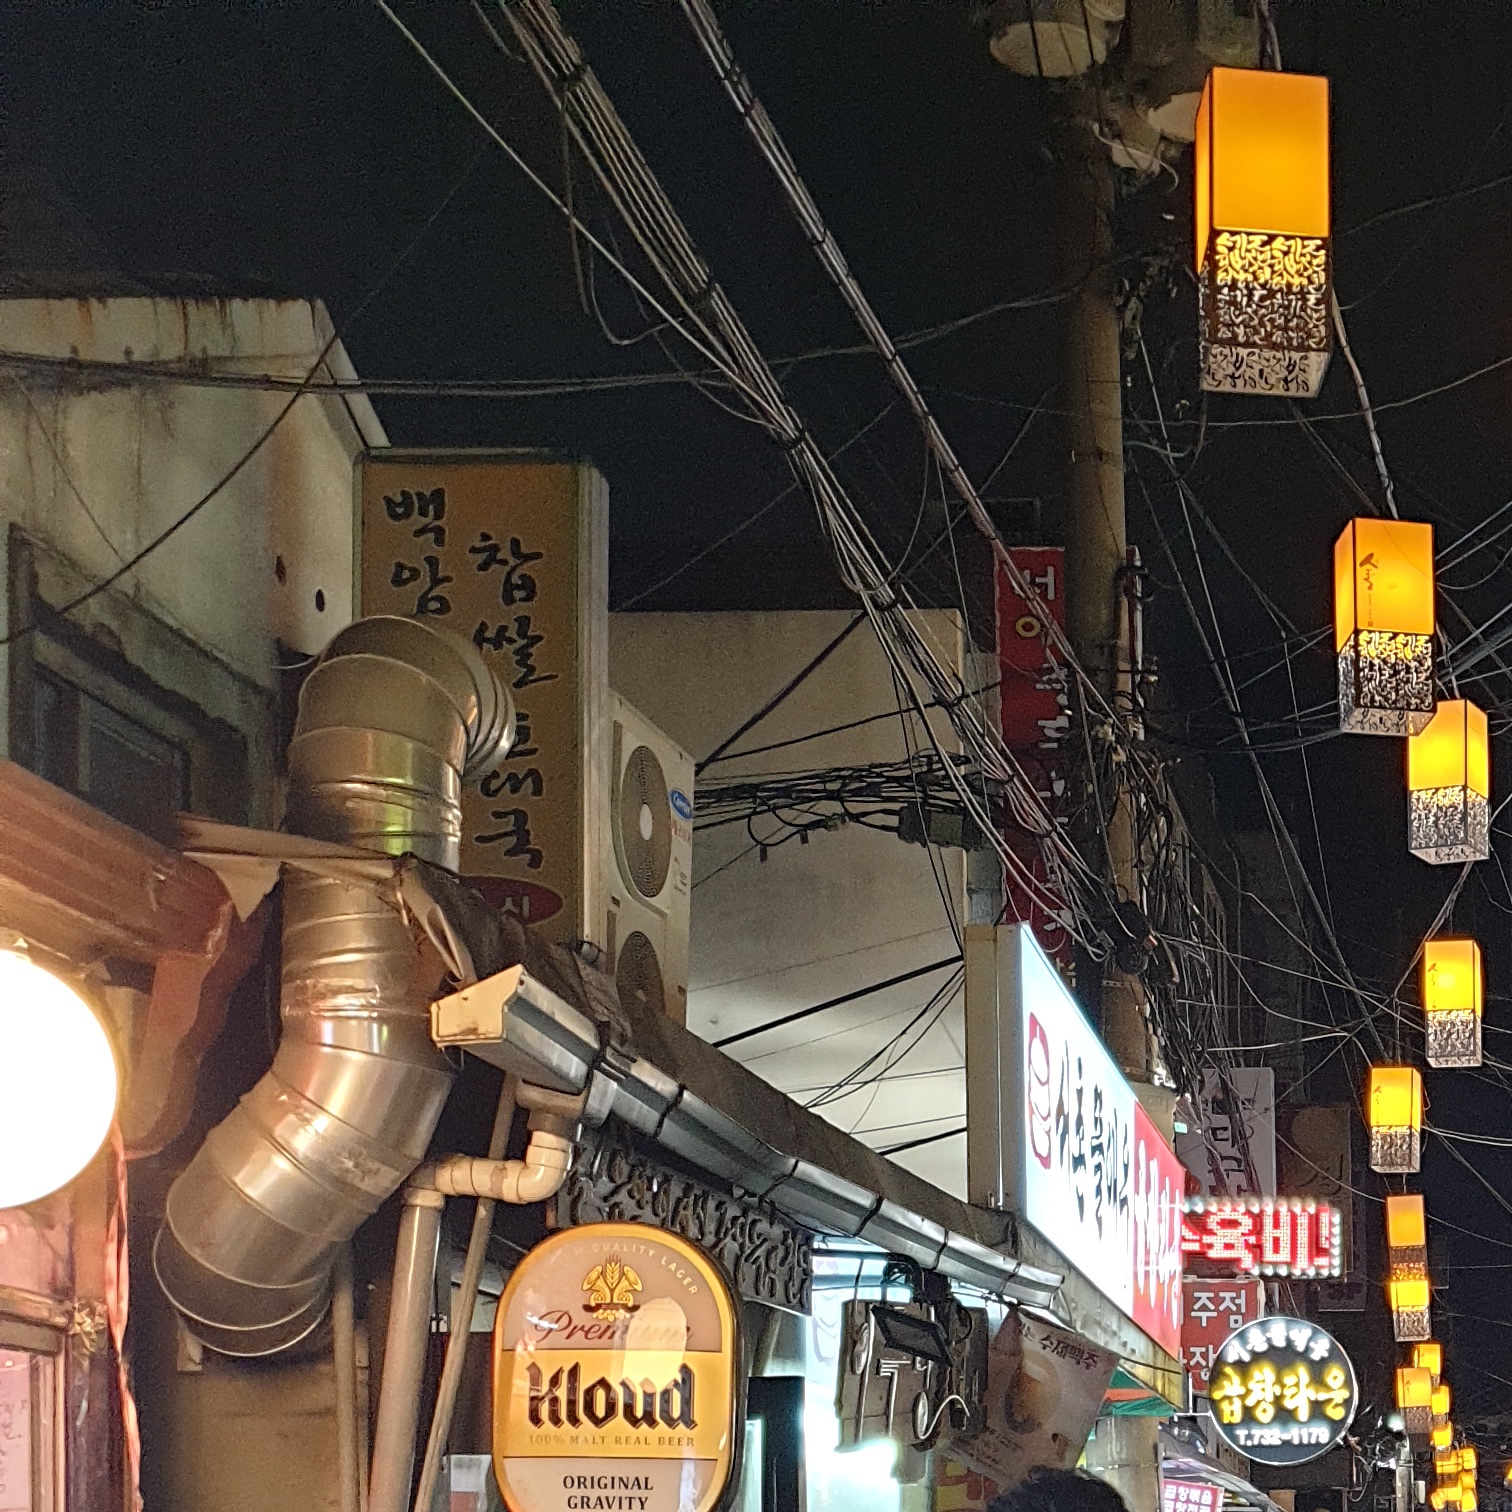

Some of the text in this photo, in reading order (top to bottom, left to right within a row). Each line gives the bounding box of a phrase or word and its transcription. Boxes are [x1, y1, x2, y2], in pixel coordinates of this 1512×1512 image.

[660, 1255, 699, 1296] LAGER
[526, 1361, 699, 1431] Kloud
[1212, 1366, 1350, 1424] 곱창타운
[569, 1434, 607, 1446] MALT
[613, 1435, 651, 1446] REAL
[657, 1435, 696, 1447] BEER
[562, 1475, 654, 1491] ORIGINAL
[567, 1495, 649, 1510] GRAVITY
